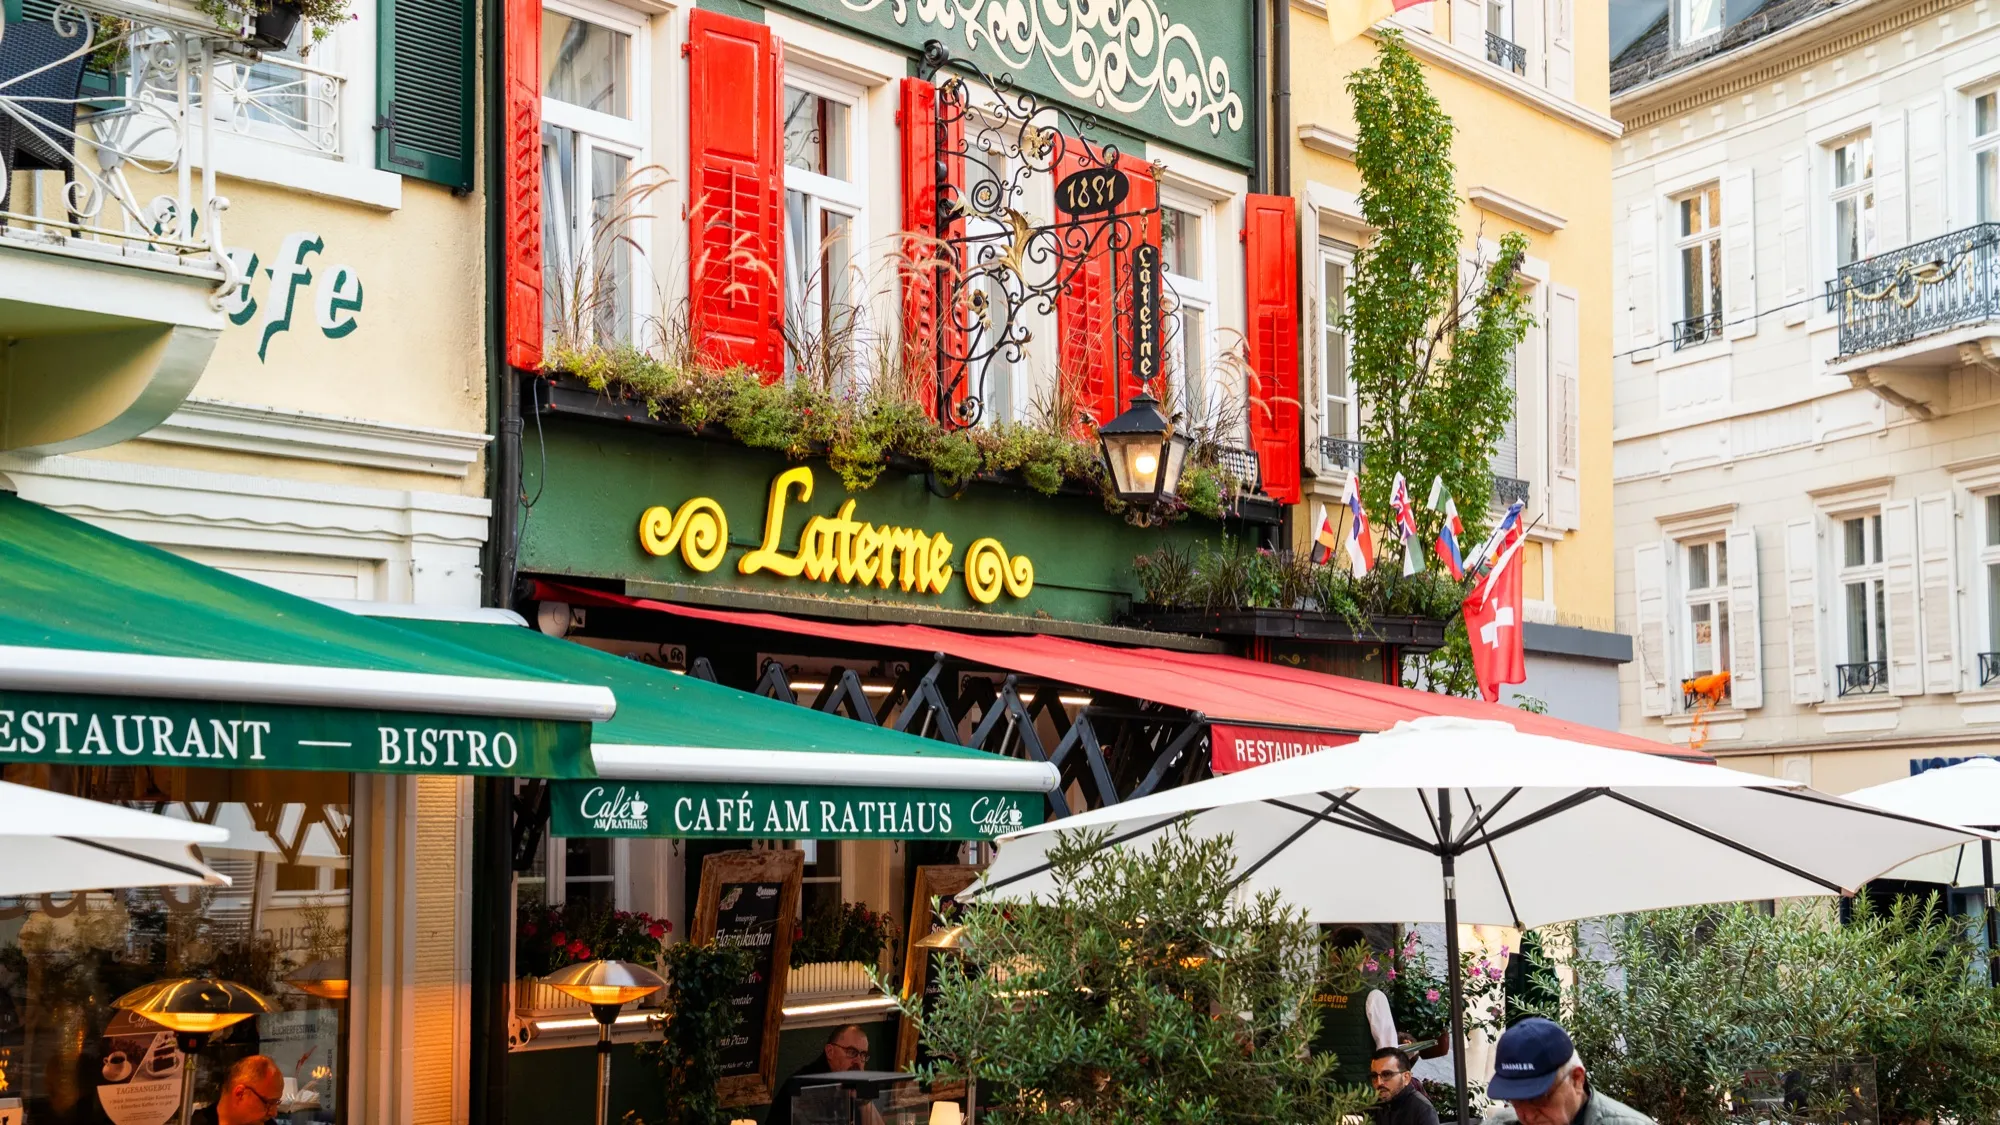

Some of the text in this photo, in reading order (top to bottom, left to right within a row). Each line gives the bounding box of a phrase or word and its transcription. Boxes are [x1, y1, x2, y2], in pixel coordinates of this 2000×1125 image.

[1138, 247, 1152, 376] Laterne
[738, 466, 954, 594] Laterne
[377, 726, 518, 768] BISTRO
[1235, 738, 1331, 764] RESTAURA
[580, 786, 632, 832] Café
[593, 819, 648, 830] AM RATHAUS
[674, 790, 953, 834] CAFÉ AM RATHAUS
[970, 796, 1010, 835] Café
[978, 824, 991, 833] AM
[1312, 992, 1348, 1003] Laterne
[1501, 1062, 1536, 1071] DAIMLER
